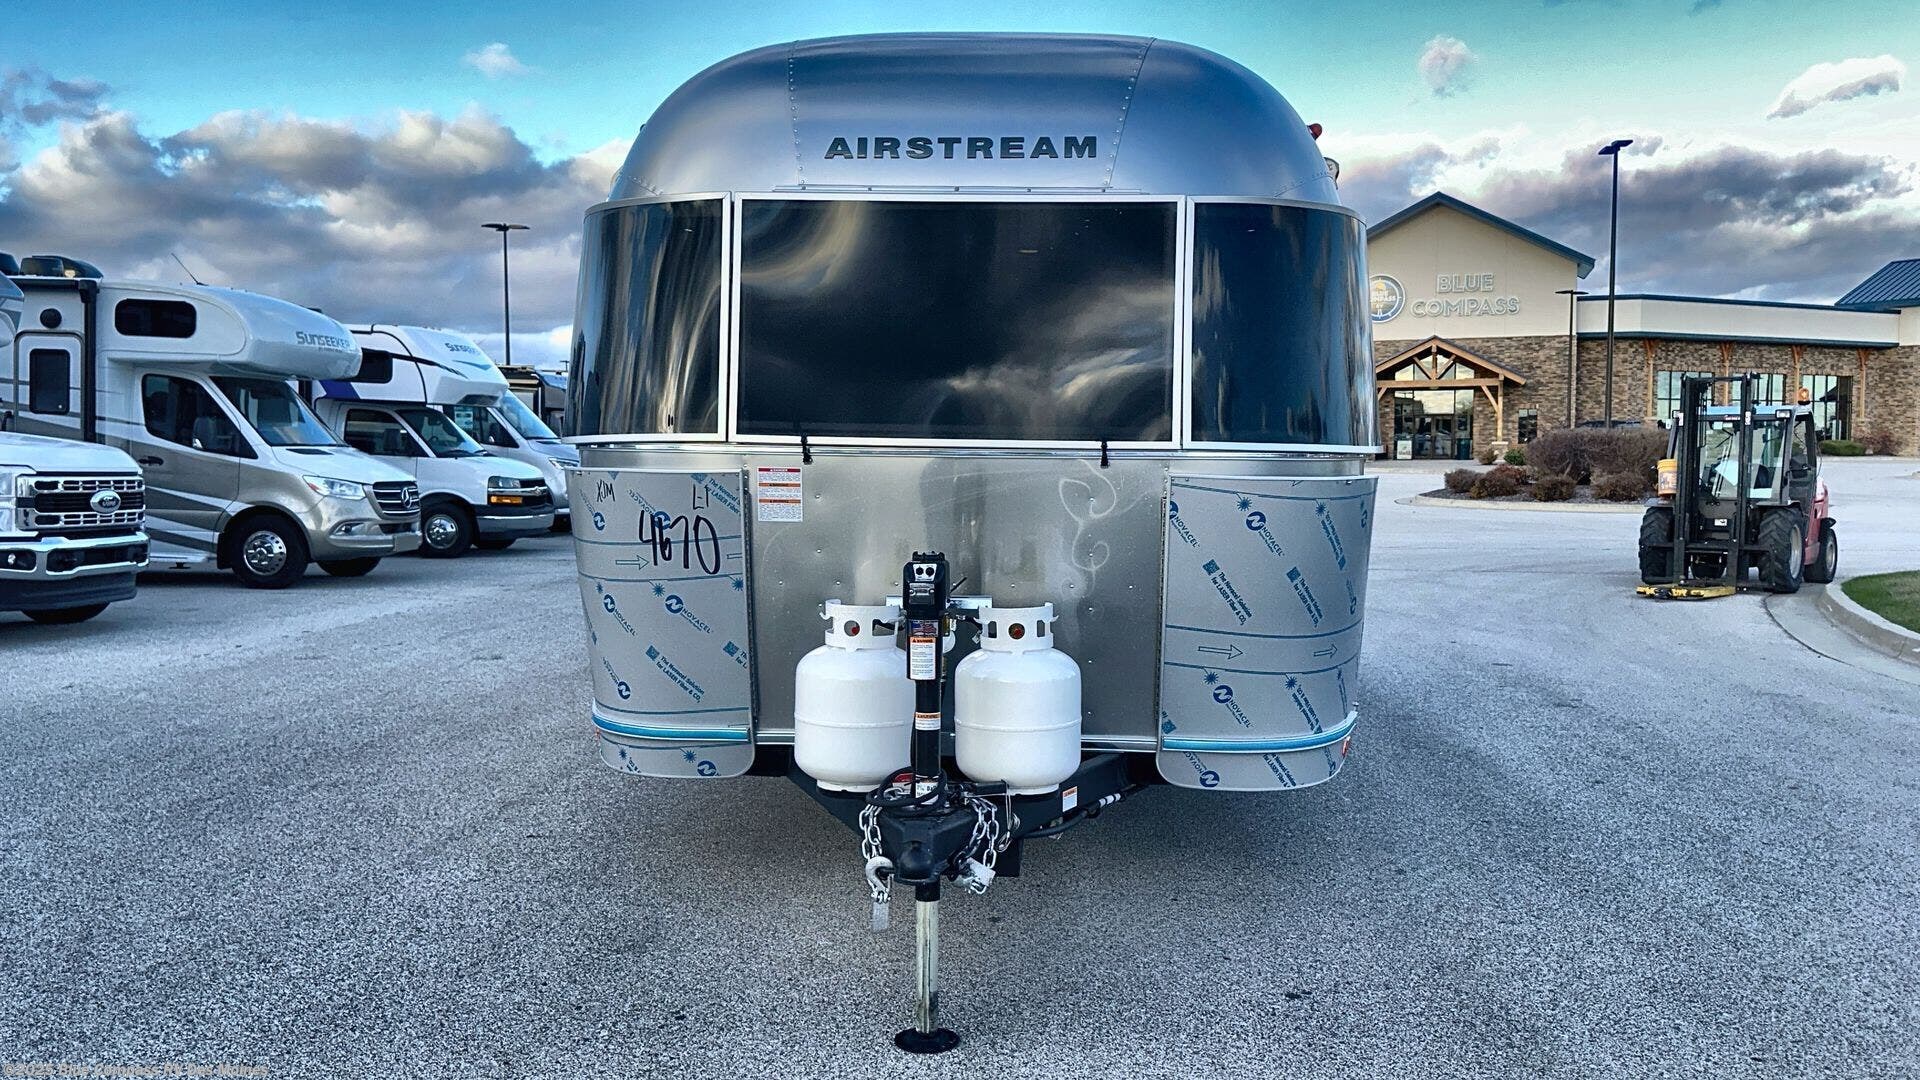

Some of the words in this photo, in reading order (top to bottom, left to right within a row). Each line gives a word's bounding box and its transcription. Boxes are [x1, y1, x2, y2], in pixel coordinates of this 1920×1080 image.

[824, 136, 1097, 159] AIRSTREAM
[1436, 272, 1494, 293] BLUE
[1410, 296, 1520, 317] COMPASS
[710, 489, 729, 505] LASER
[639, 510, 720, 574] 4670
[1174, 516, 1198, 548] NOVACEL
[1262, 526, 1283, 556] NOVACEL
[682, 608, 711, 634] NOVACEL
[1230, 698, 1252, 728] NOVACEL
